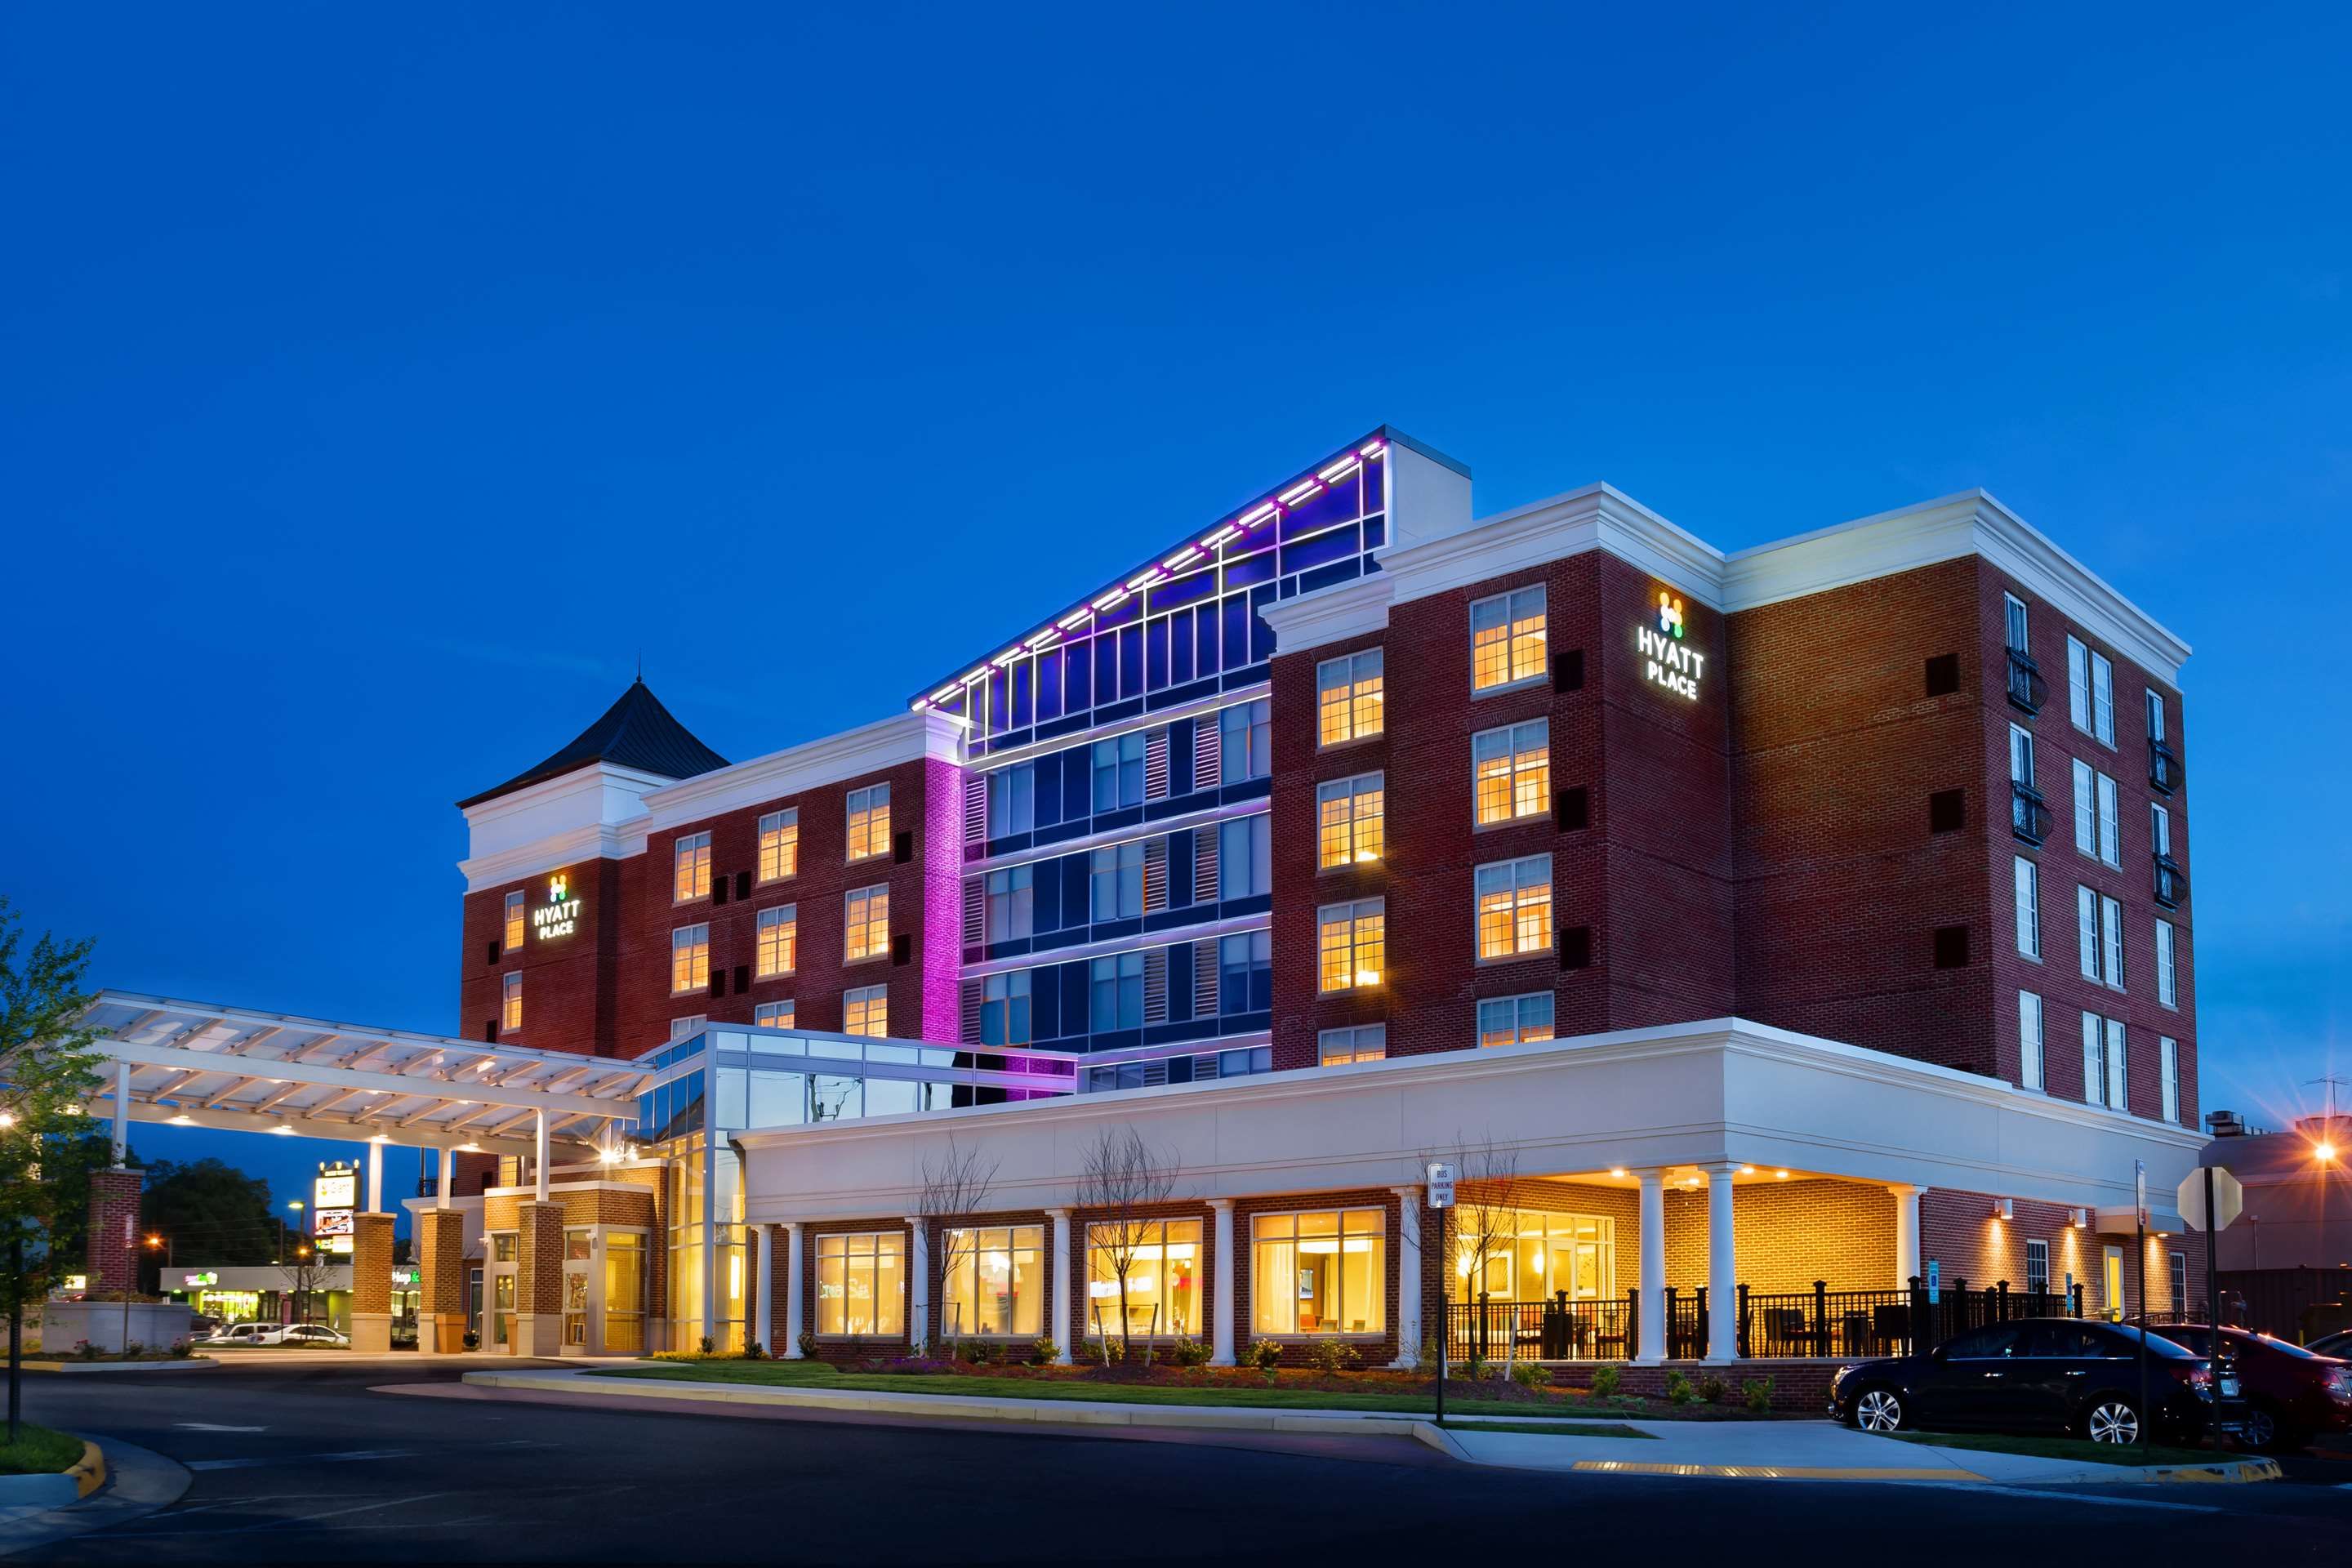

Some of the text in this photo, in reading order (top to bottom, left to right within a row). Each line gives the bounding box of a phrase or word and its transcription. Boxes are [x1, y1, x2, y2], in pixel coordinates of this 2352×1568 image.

[1638, 626, 1704, 679] HYATT
[1648, 661, 1697, 700] PLACE
[535, 900, 580, 926] HYATT
[540, 920, 573, 940] PLACE
[1437, 1169, 1448, 1178] BUS
[1431, 1181, 1453, 1190] PARKING
